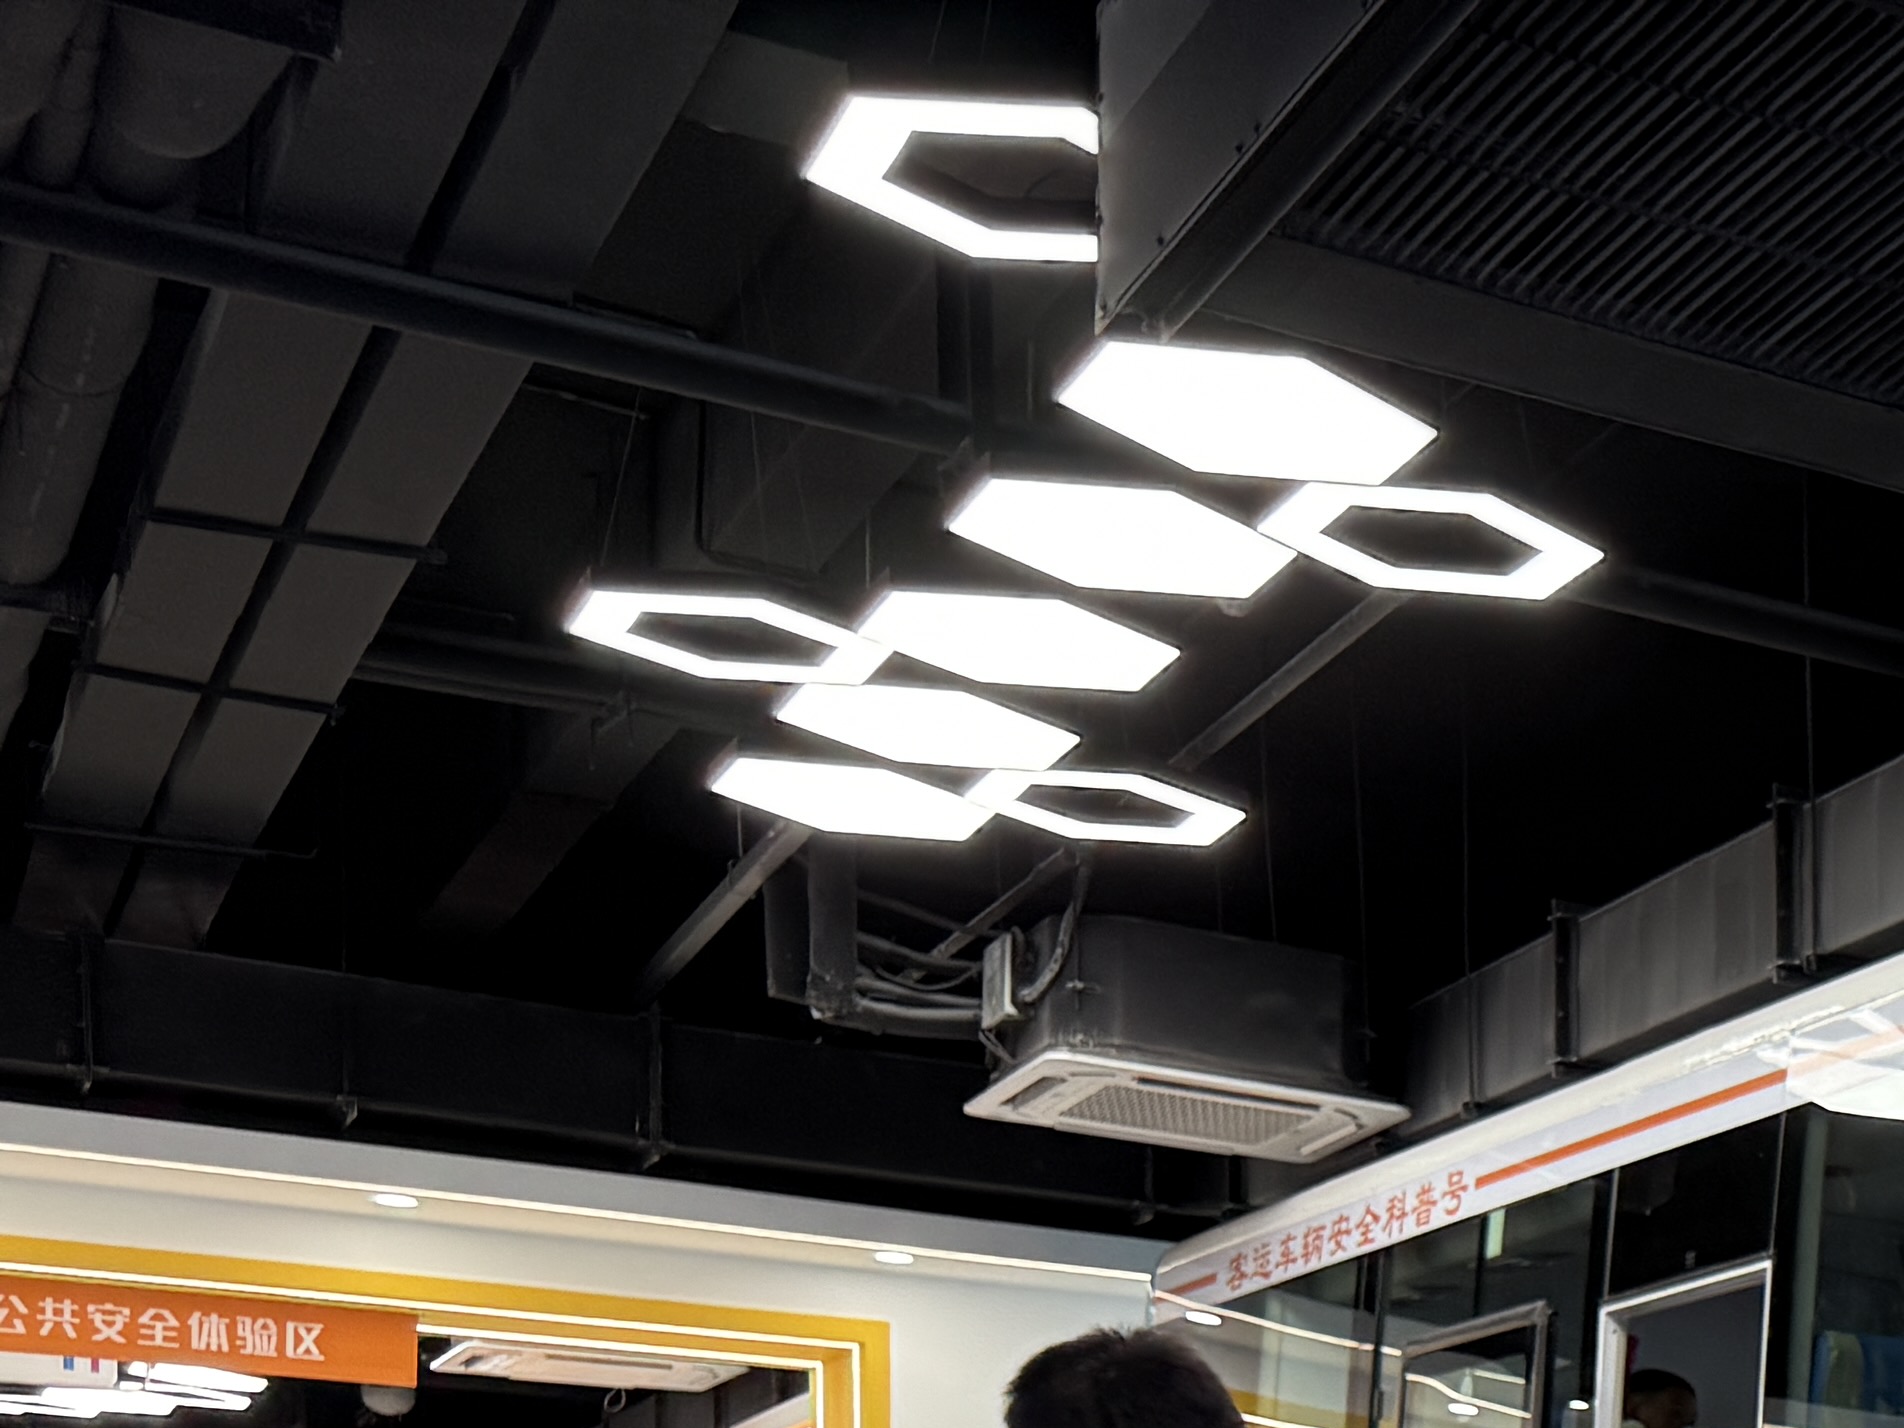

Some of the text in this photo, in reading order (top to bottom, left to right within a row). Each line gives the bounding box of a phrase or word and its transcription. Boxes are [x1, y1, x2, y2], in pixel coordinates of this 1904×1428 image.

[1225, 1170, 1470, 1293] 客运车辆安全科普号
